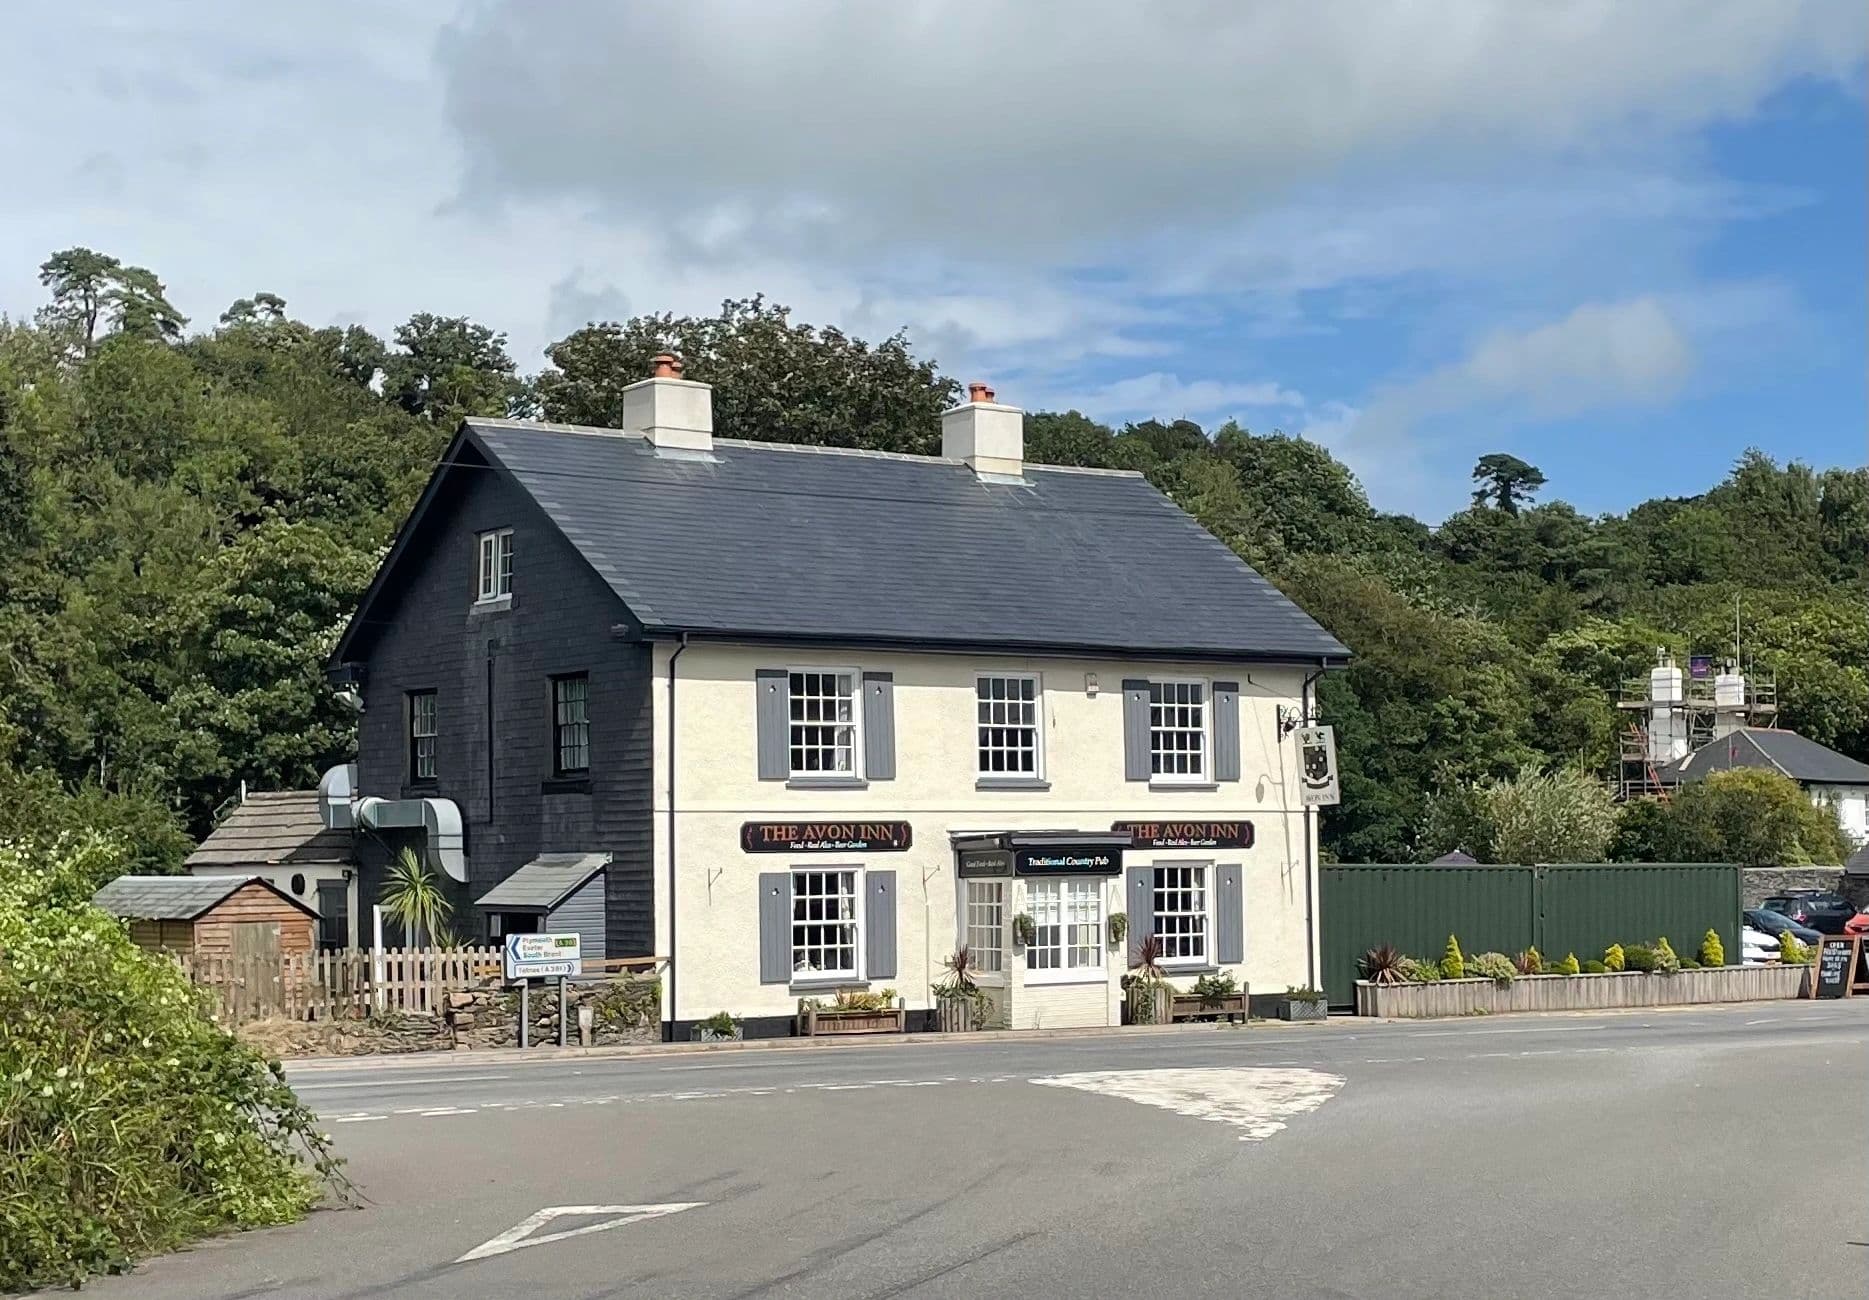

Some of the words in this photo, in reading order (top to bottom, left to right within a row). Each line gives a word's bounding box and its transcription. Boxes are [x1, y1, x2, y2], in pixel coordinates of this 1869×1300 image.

[760, 825, 798, 841] THE
[803, 824, 856, 840] AVON
[859, 824, 893, 840] INN
[1127, 824, 1160, 838] THE
[1163, 823, 1206, 838] AVON
[1210, 823, 1240, 838] INN
[790, 841, 804, 849] Food
[847, 840, 868, 848] Garden
[1152, 838, 1165, 846] Food
[1028, 857, 1065, 866] Traditional
[1066, 857, 1093, 867] Country
[1095, 856, 1109, 866] Pub
